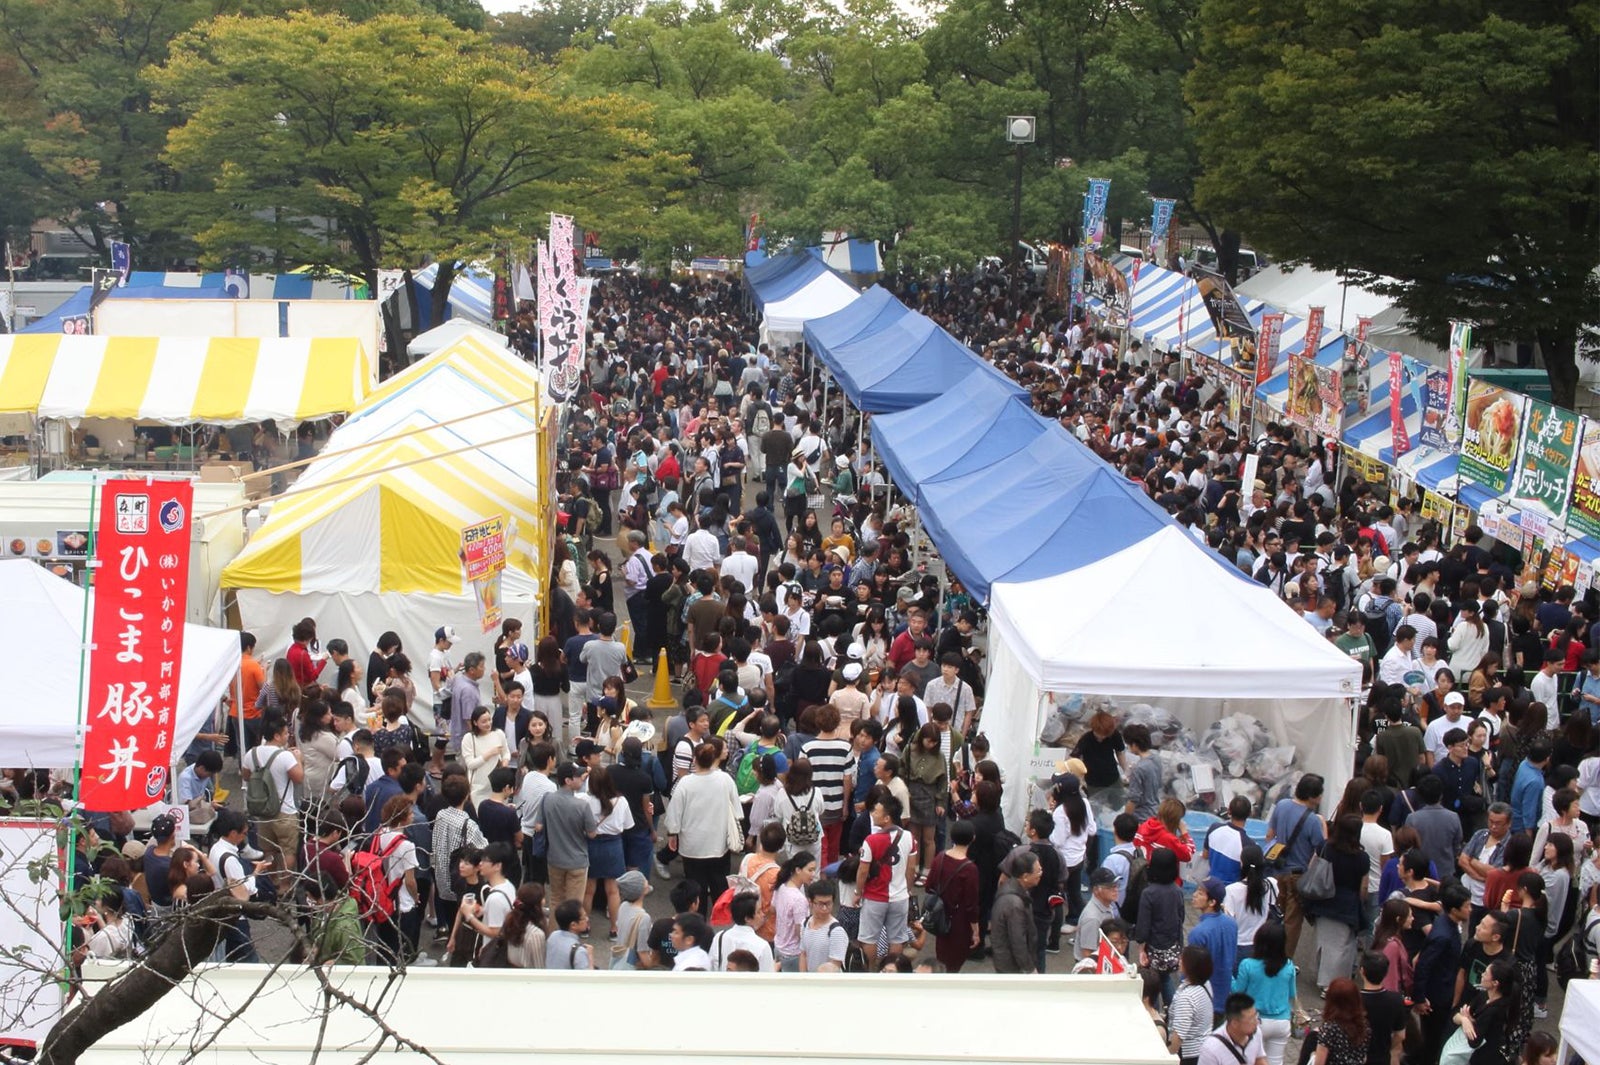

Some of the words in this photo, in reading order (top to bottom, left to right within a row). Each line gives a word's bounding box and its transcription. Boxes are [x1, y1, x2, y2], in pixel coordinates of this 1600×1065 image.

[97, 545, 155, 790] ひこま豚丼
[154, 554, 179, 750] (株)いかめし阿部商店
[1030, 759, 1056, 768] わりばし
